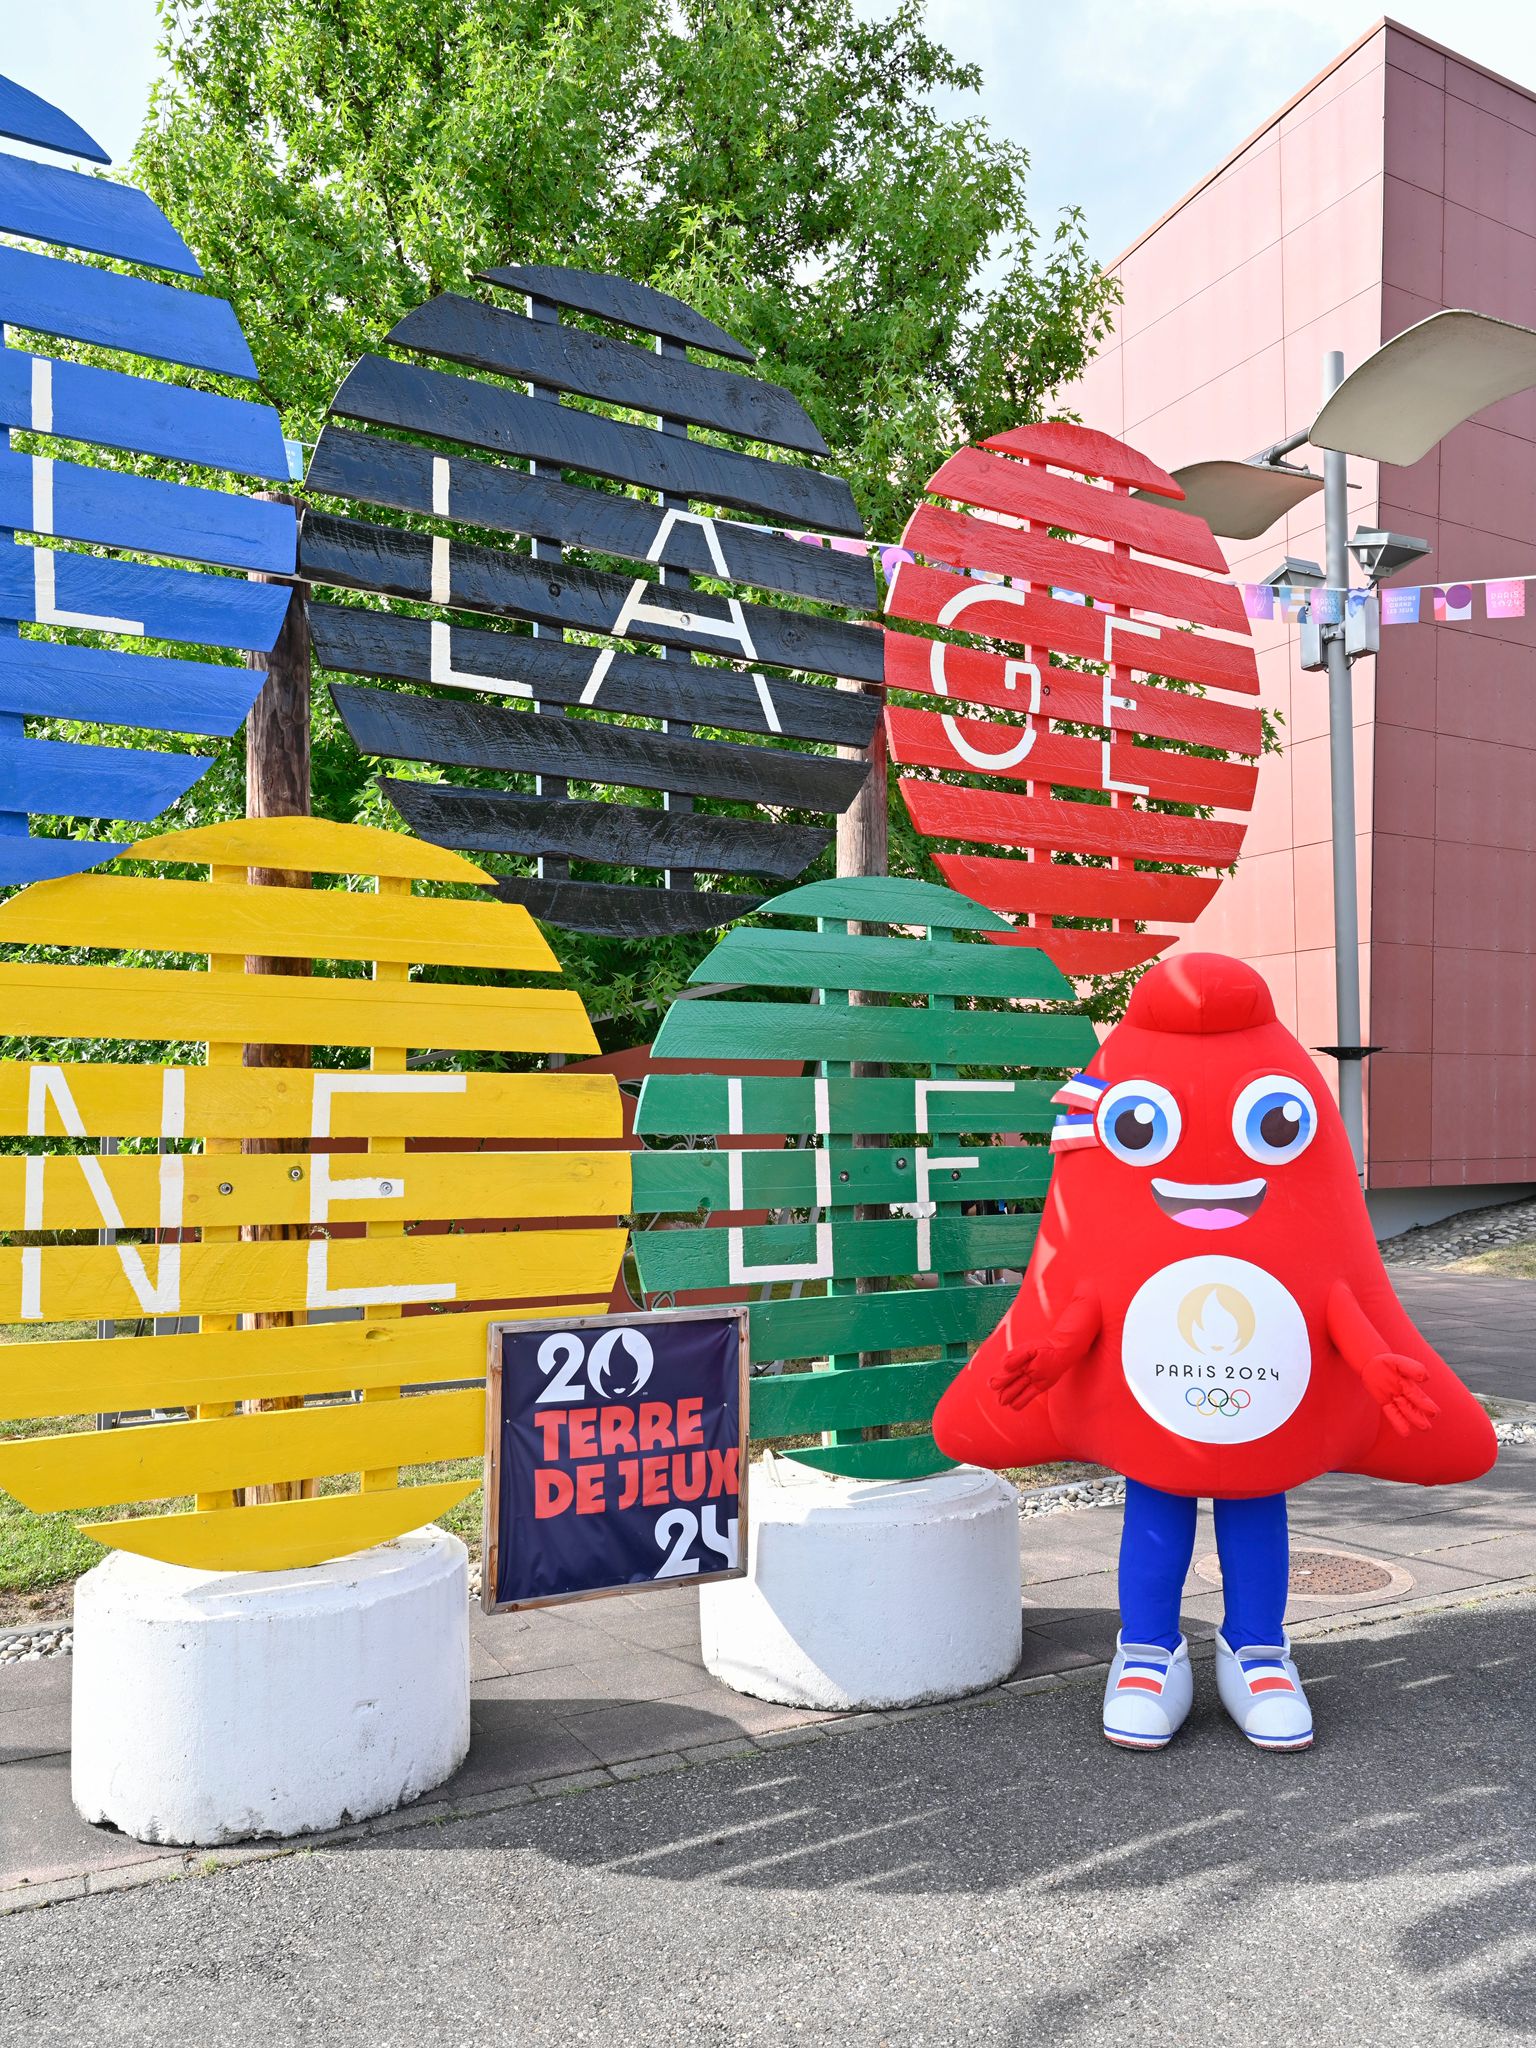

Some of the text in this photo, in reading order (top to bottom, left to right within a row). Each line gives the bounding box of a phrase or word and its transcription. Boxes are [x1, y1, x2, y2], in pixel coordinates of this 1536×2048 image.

[1225, 1366, 1280, 1381] 2024
[534, 1397, 704, 1461] TERRE
[534, 1447, 739, 1519] DE JEUX
[653, 1504, 739, 1579] 24
